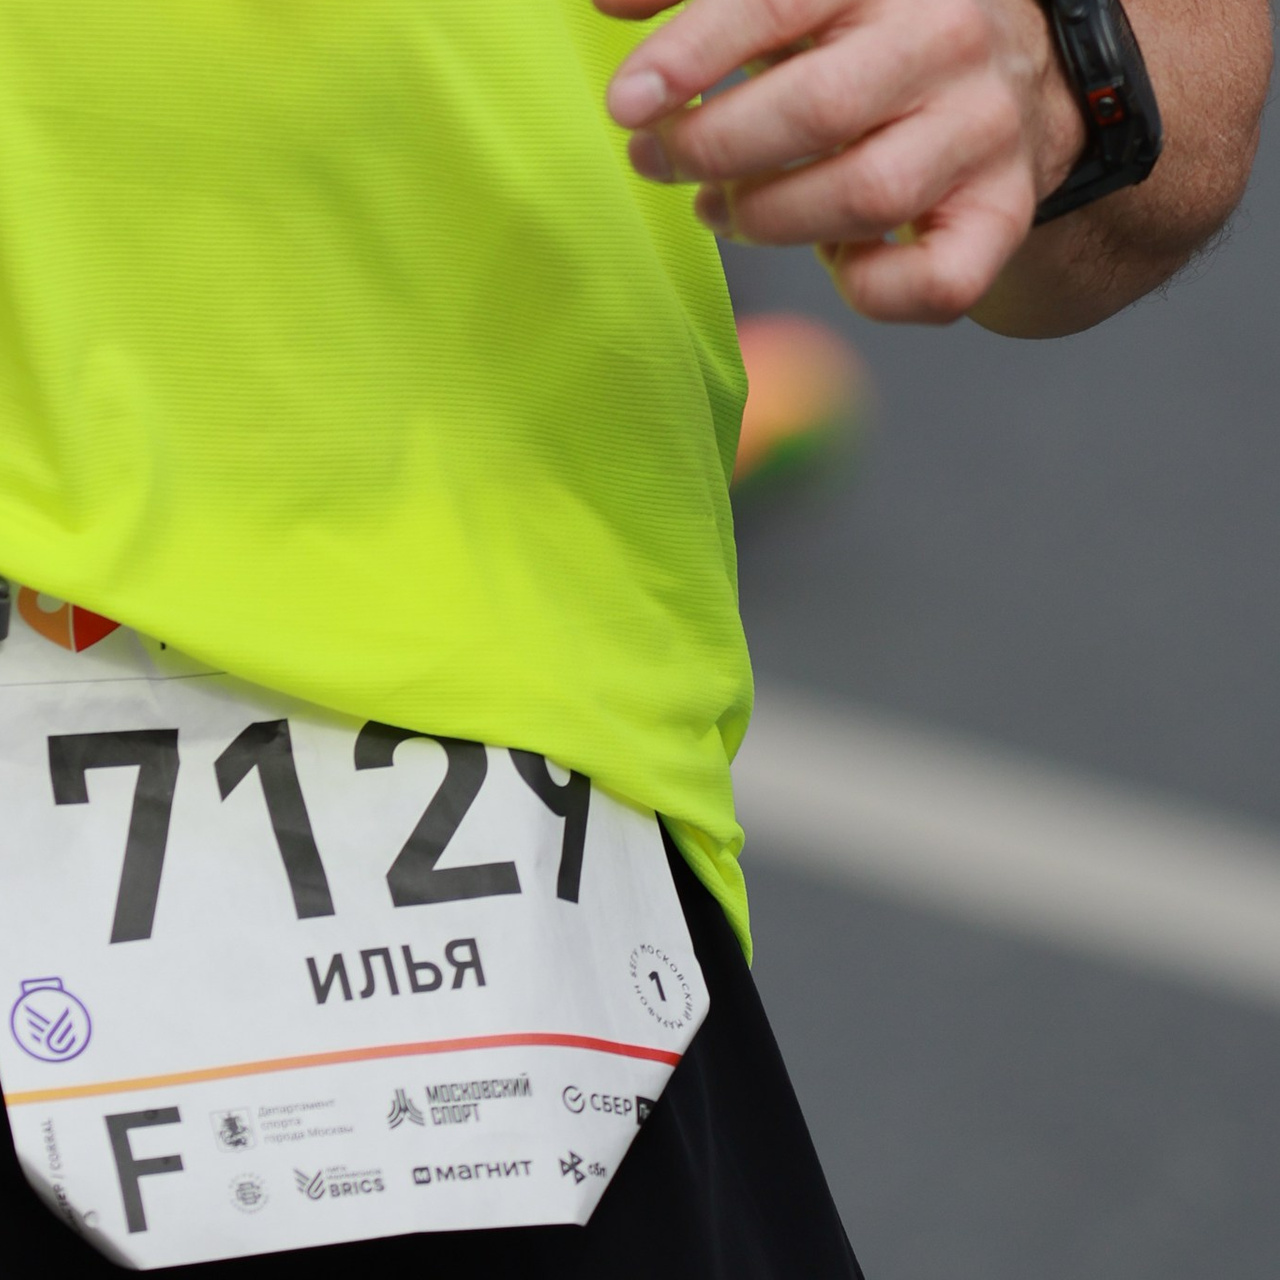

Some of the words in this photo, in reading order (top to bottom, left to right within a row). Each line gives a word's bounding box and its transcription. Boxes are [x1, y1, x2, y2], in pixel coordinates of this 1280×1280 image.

[306, 938, 488, 1005] ИЛЬЯ
[648, 970, 667, 1002] 1
[426, 1072, 533, 1104] МОСКОВСКИЙ
[590, 1093, 633, 1115] СБЕР
[431, 1103, 480, 1126] СПОРТ
[104, 1106, 185, 1234] F
[330, 1178, 385, 1197] BRICS
